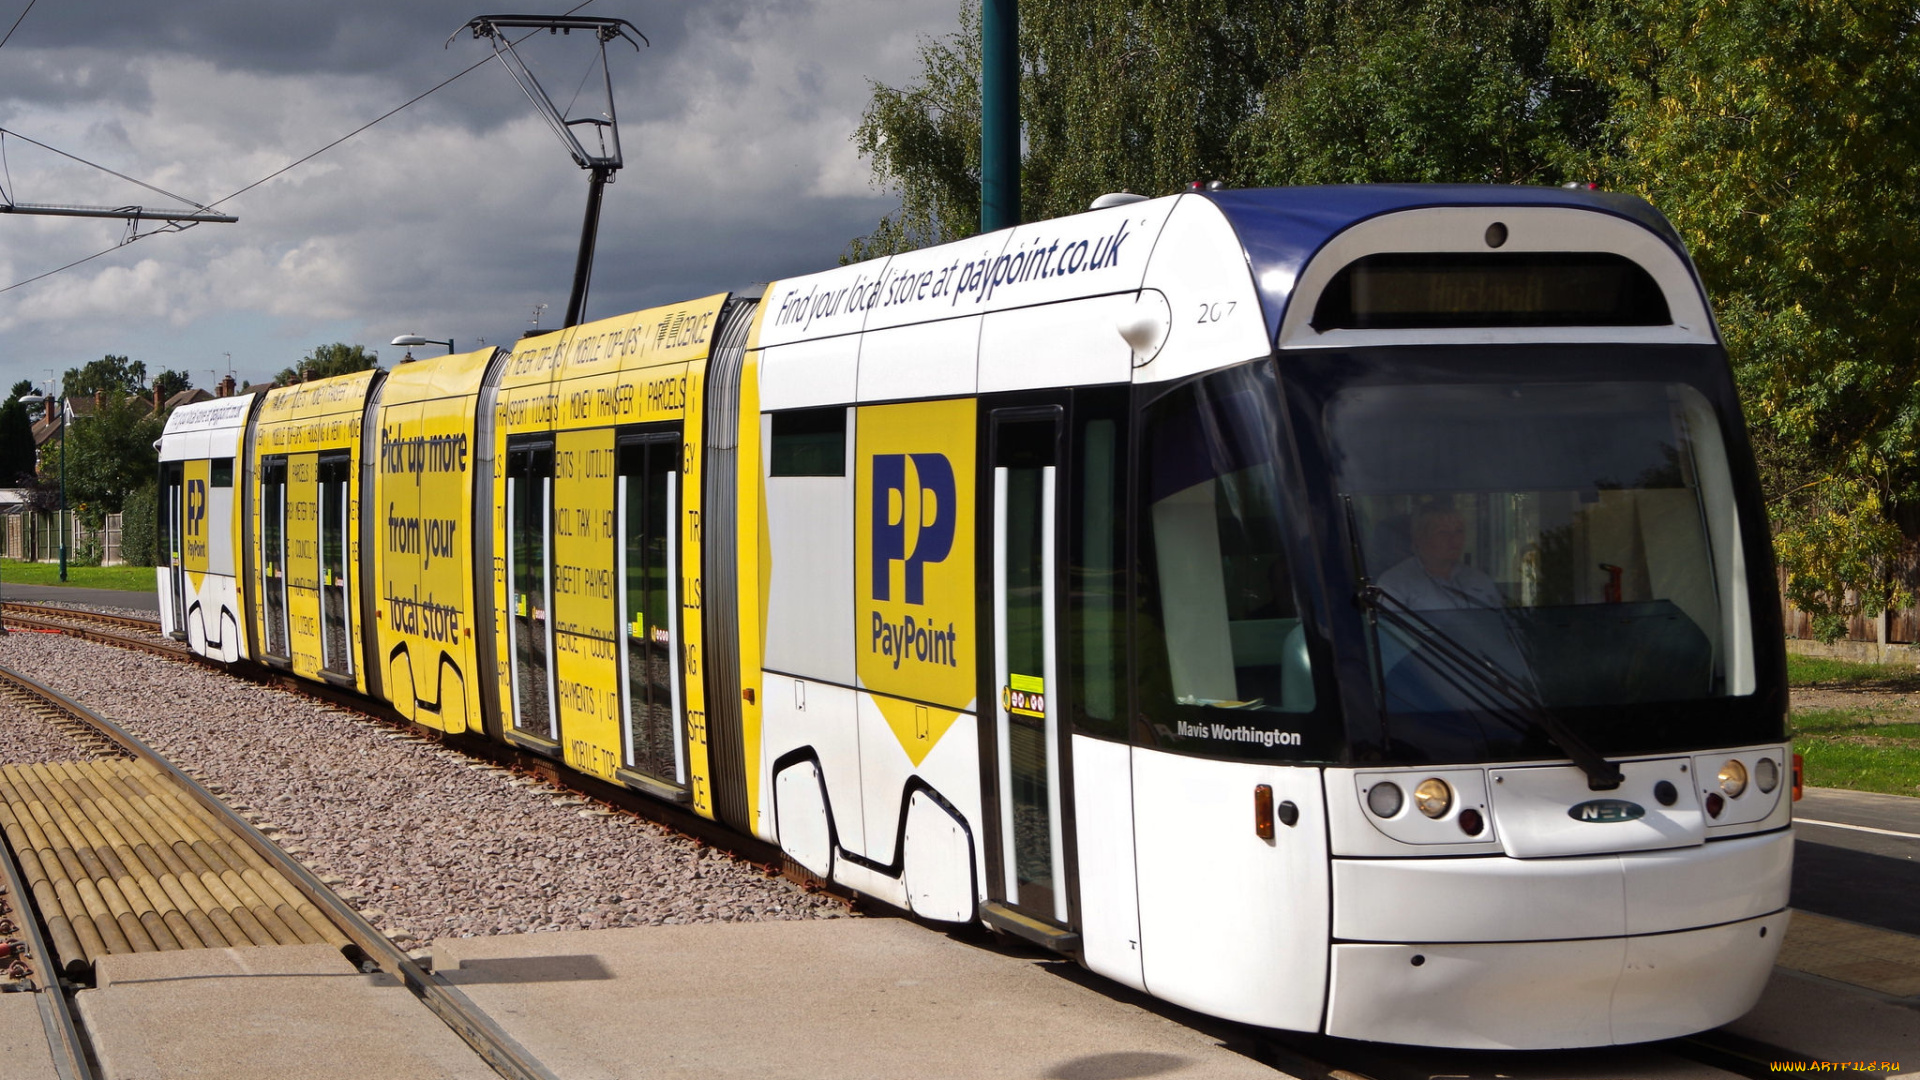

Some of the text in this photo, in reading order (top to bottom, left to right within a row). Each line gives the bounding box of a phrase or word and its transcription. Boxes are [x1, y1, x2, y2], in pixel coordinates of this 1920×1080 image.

[775, 219, 1130, 332] Find your local store at paypoint.co.uk
[1197, 301, 1237, 323] 207
[496, 377, 687, 427] TRANSPORT TICKETS MONEY TRANSFER PARCELS
[381, 423, 467, 487] Pick up more
[389, 501, 456, 570] from your
[577, 509, 590, 537] TAX
[389, 580, 419, 636] local
[423, 592, 459, 645] store
[872, 611, 956, 670] PayPoint
[560, 680, 617, 721] PAYMENTS UT
[1178, 721, 1301, 747] Mavis Worthington
[572, 739, 599, 775] MOBILE
[1581, 806, 1632, 820] NET
